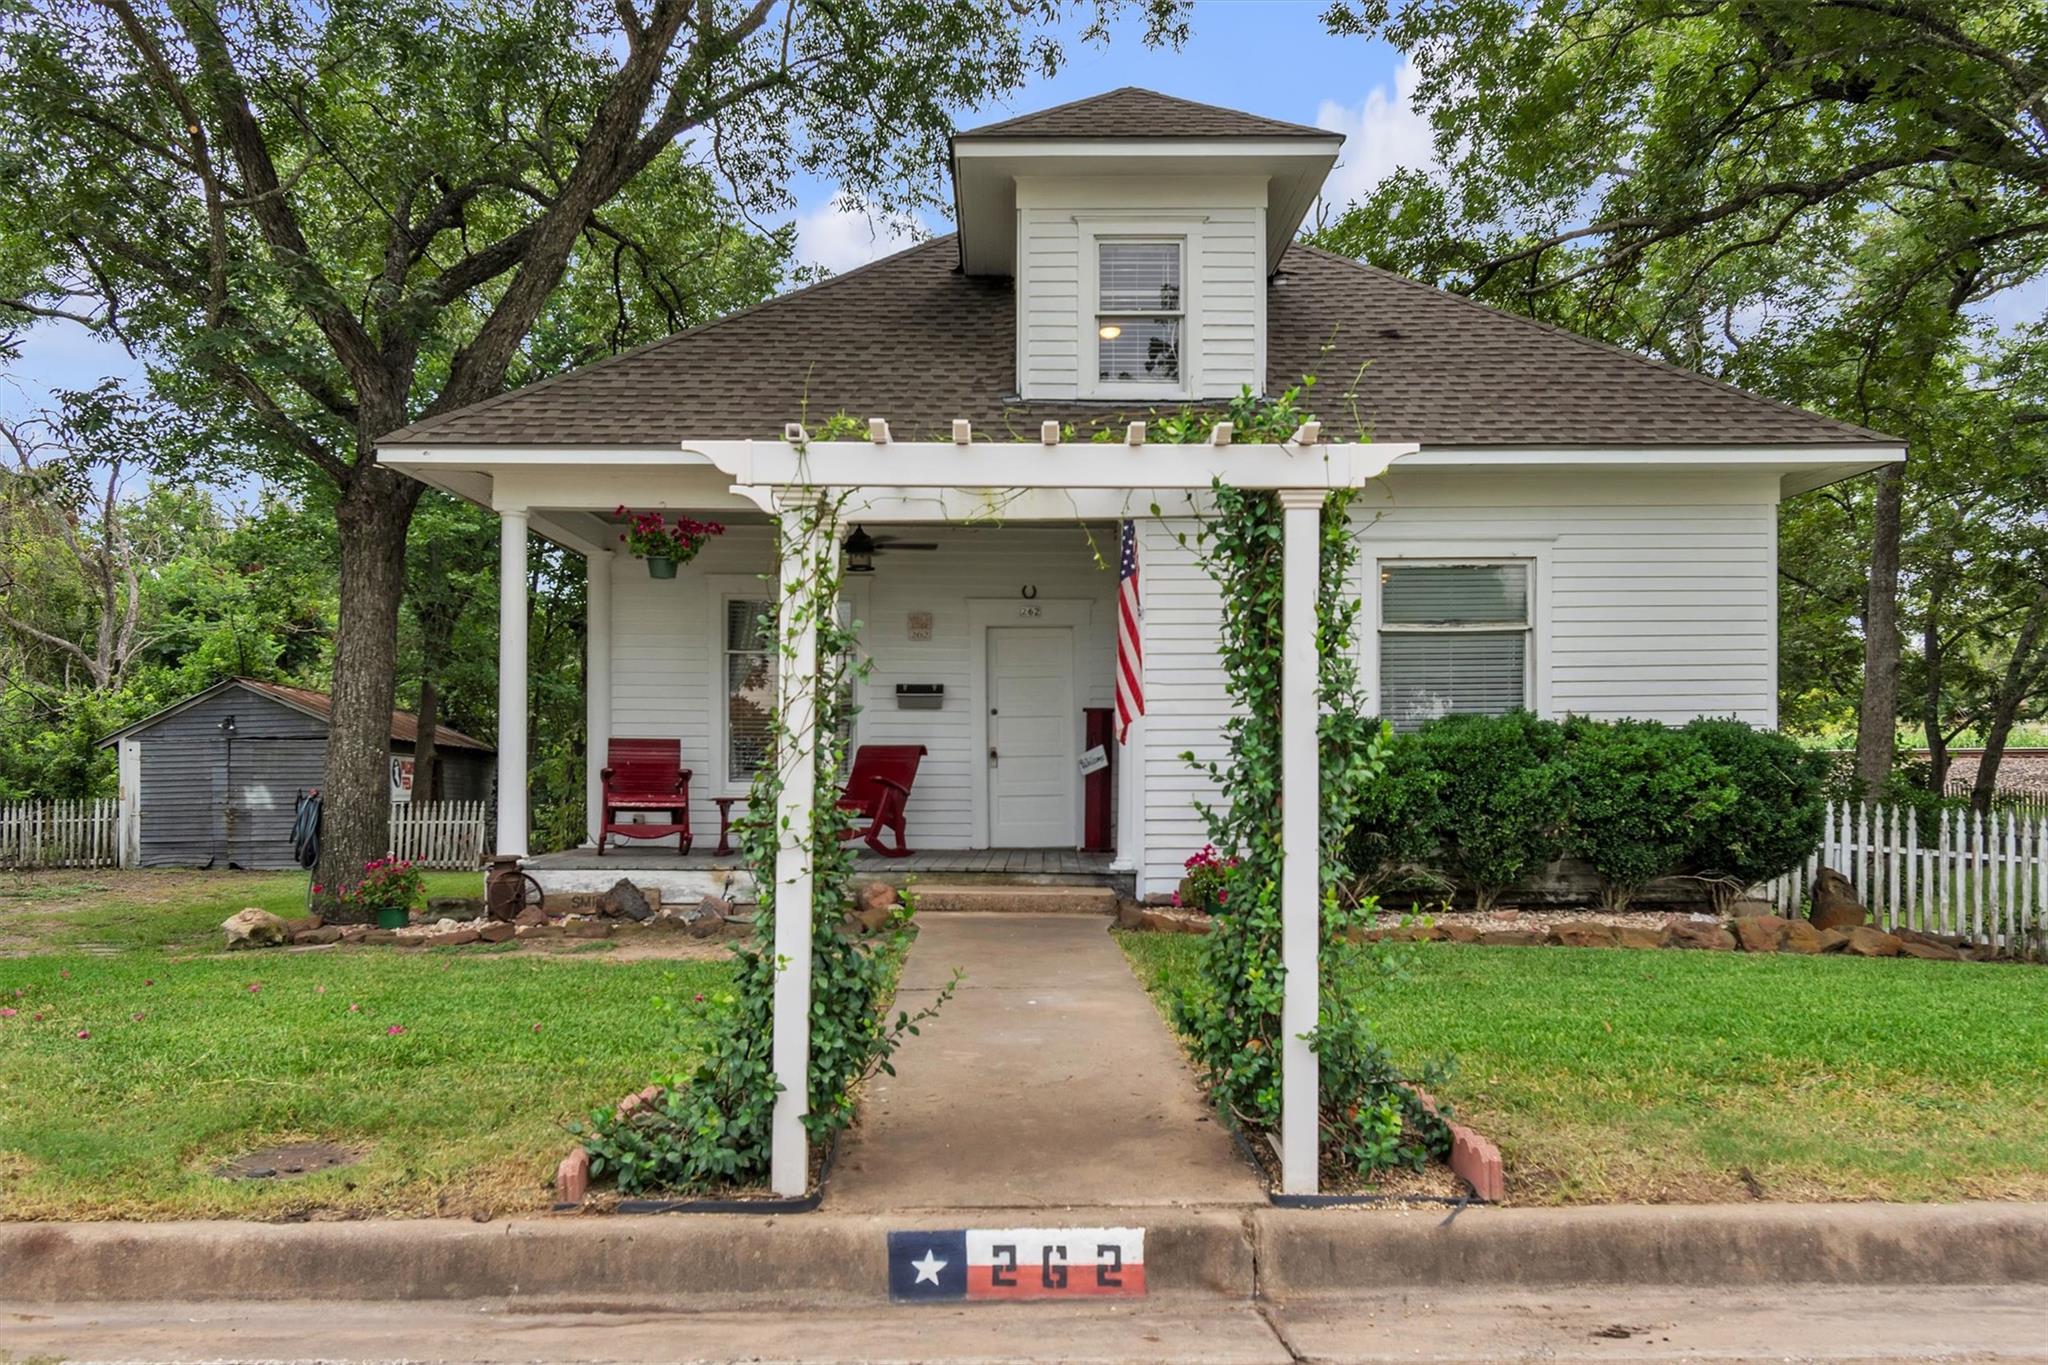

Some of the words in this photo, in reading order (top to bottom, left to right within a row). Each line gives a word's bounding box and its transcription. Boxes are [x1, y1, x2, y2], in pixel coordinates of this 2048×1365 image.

[1020, 607, 1040, 617] 262
[571, 895, 597, 909] SMI
[992, 1244, 1122, 1289] 262
